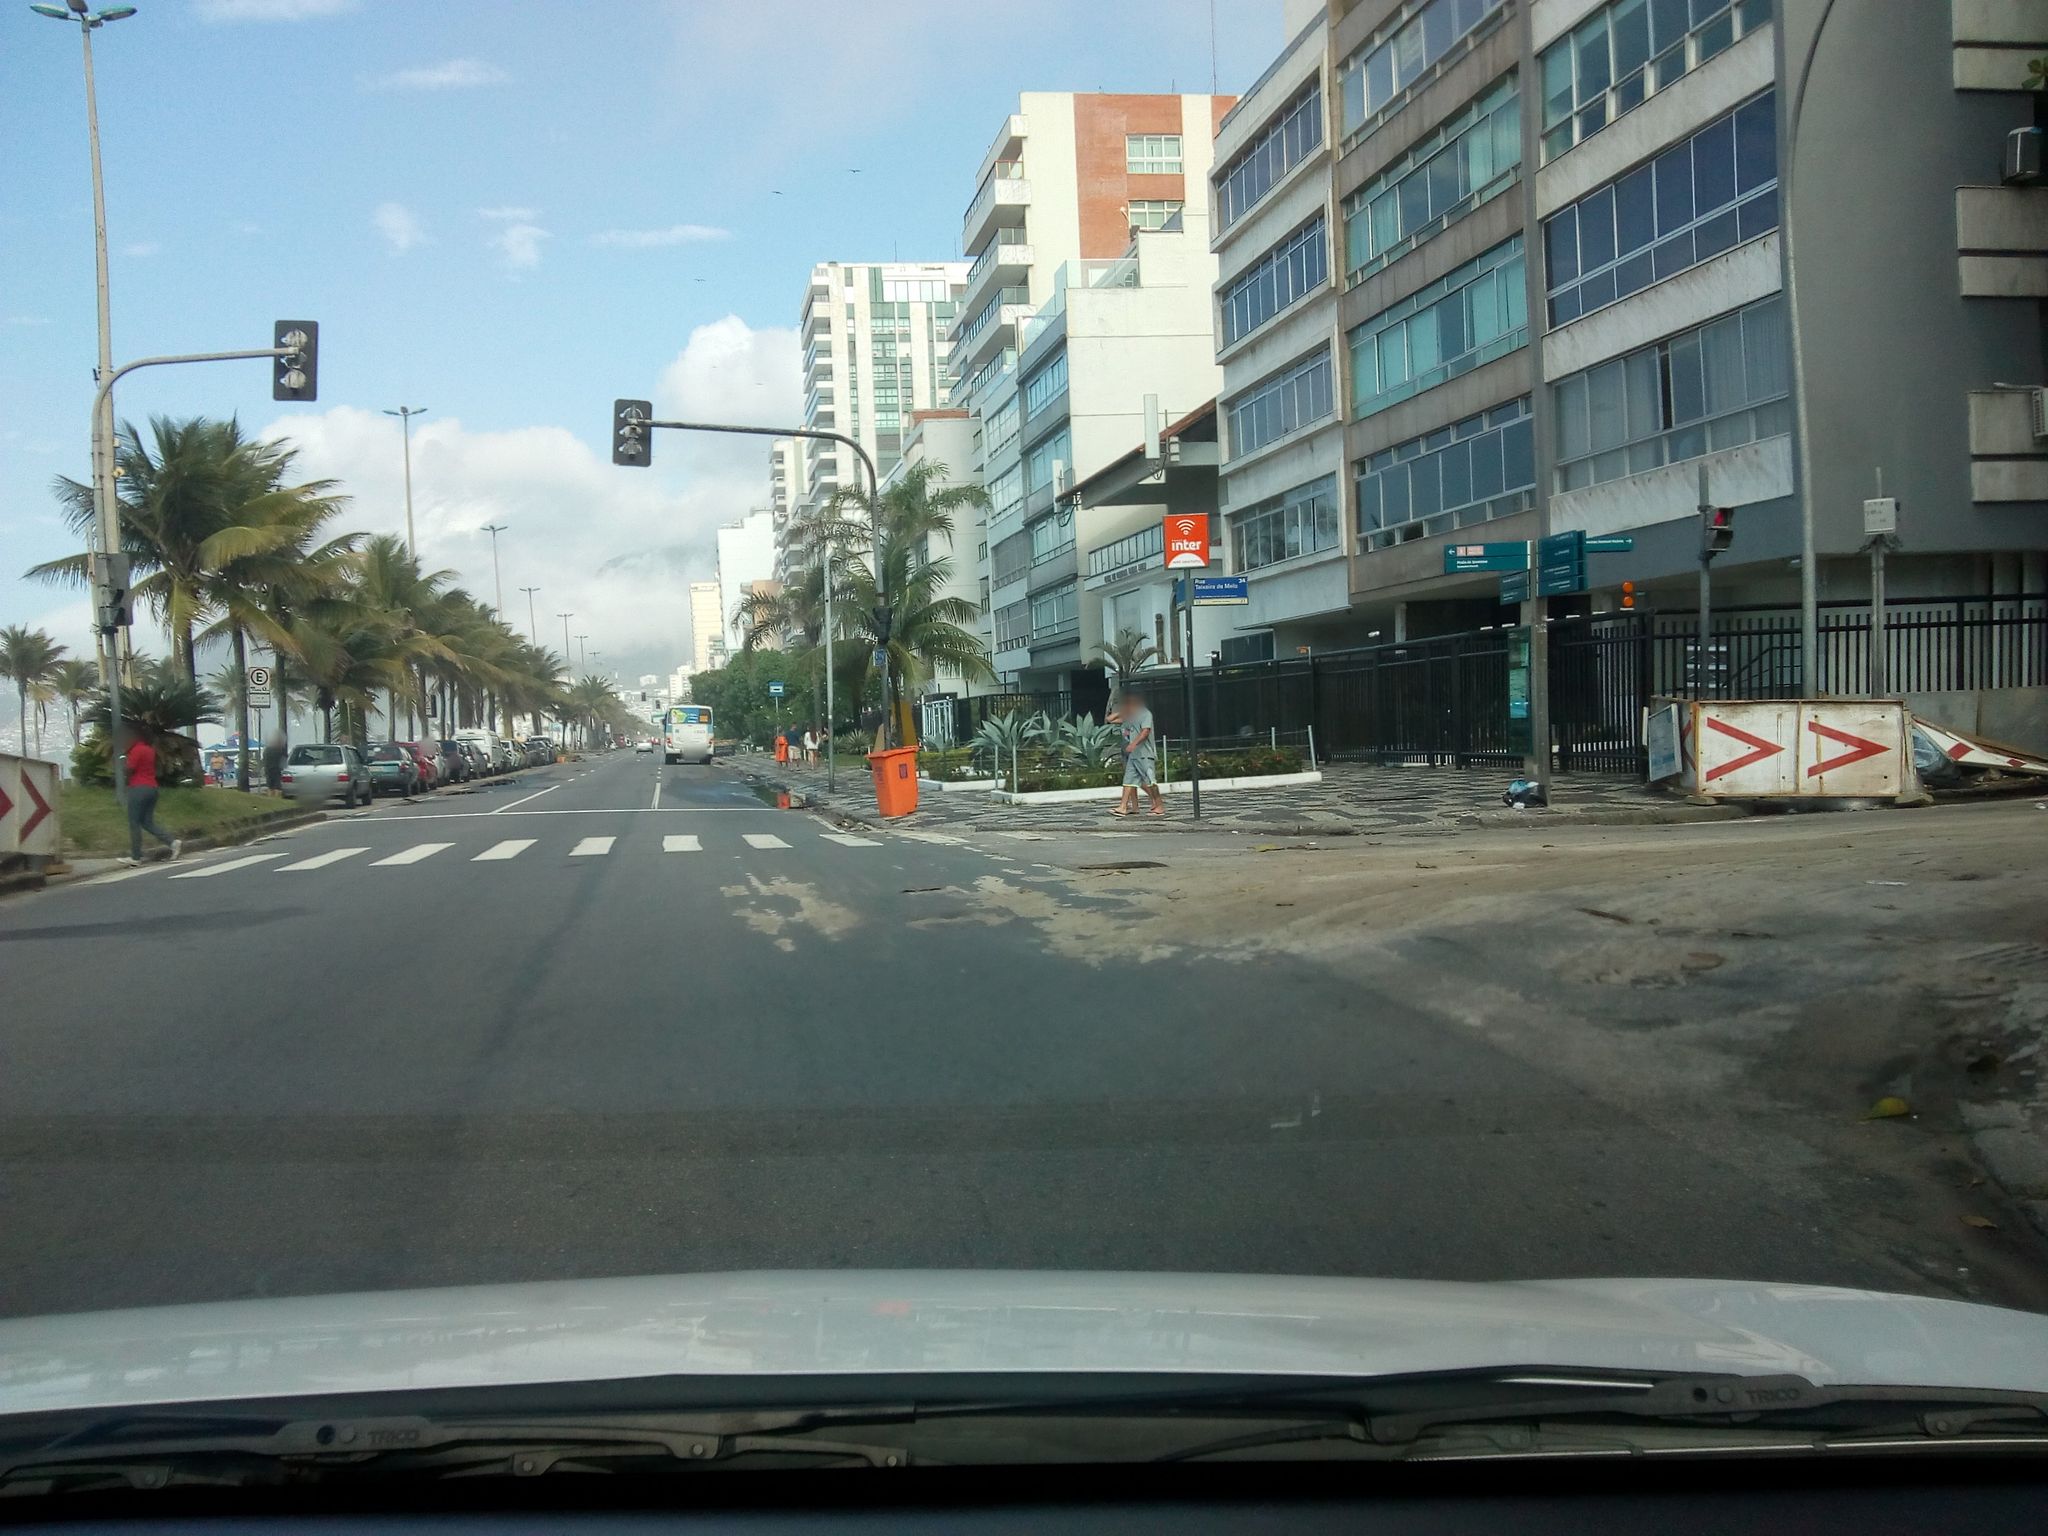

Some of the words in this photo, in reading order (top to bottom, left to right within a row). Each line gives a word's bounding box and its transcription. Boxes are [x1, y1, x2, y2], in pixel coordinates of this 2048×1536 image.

[1171, 539, 1202, 551] inter
[256, 672, 263, 682] E
[1745, 1388, 1800, 1402] TRICO
[368, 1429, 420, 1443] TRICO
